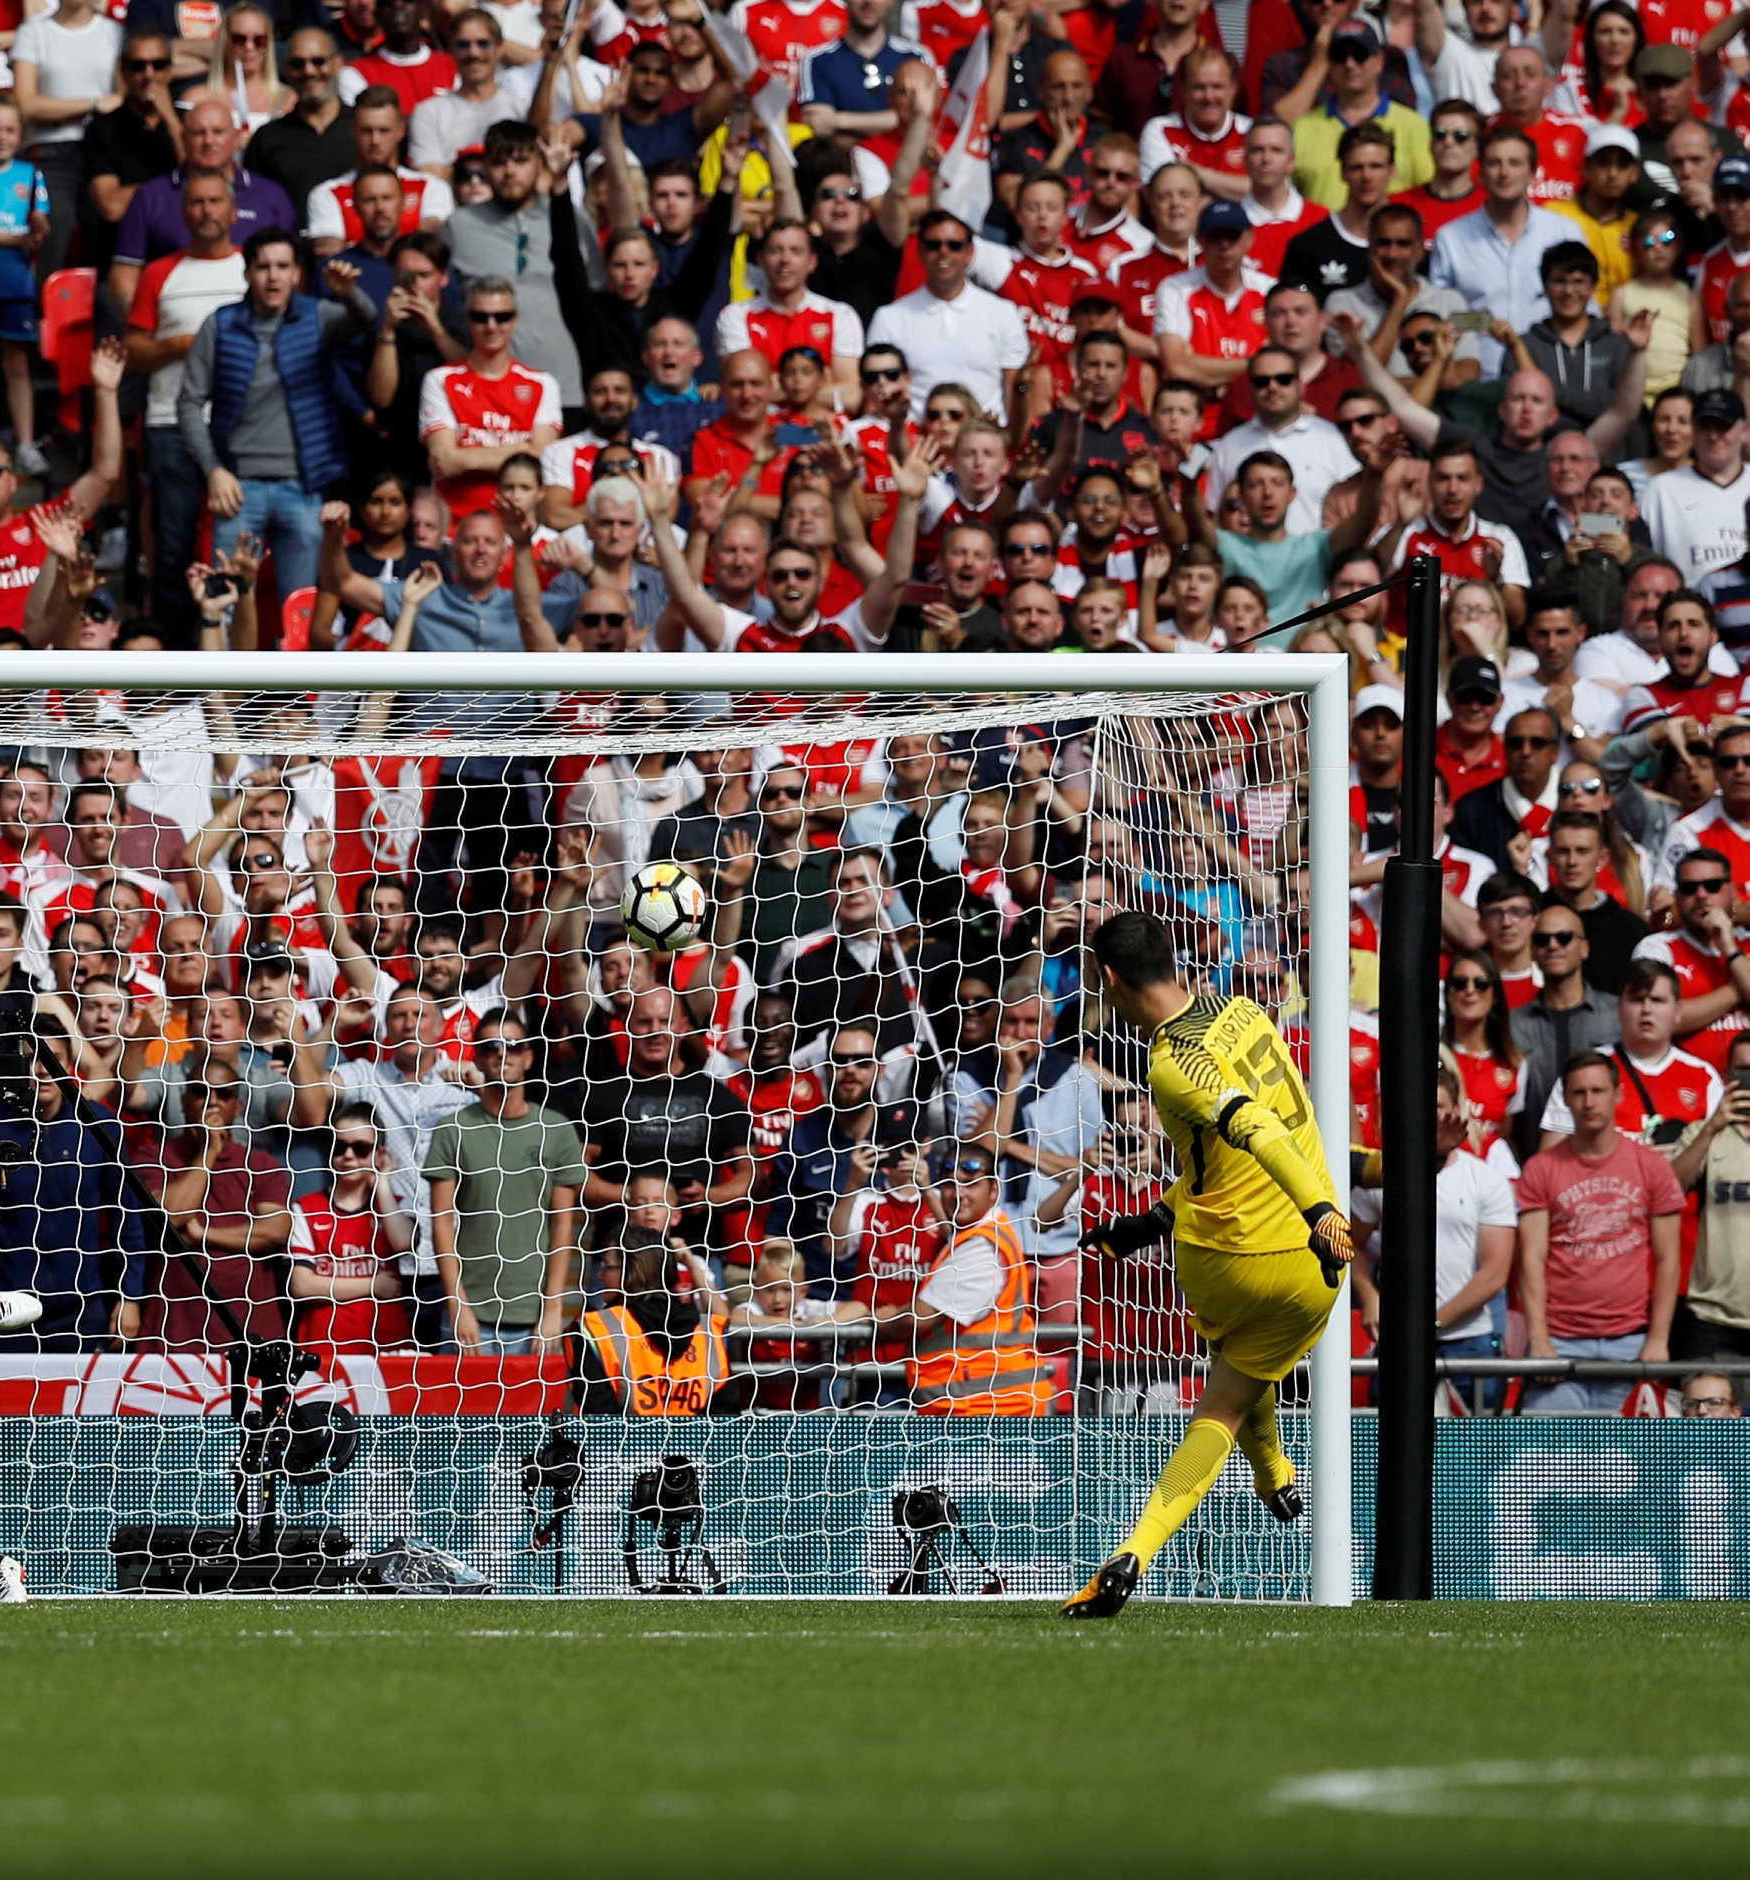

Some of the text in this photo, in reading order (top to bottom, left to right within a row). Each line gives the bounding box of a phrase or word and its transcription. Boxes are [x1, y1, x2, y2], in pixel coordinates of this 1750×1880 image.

[1209, 998, 1261, 1058] OURTOIS
[1233, 1033, 1308, 1131] 13
[1556, 1175, 1643, 1210] PHYSICAL
